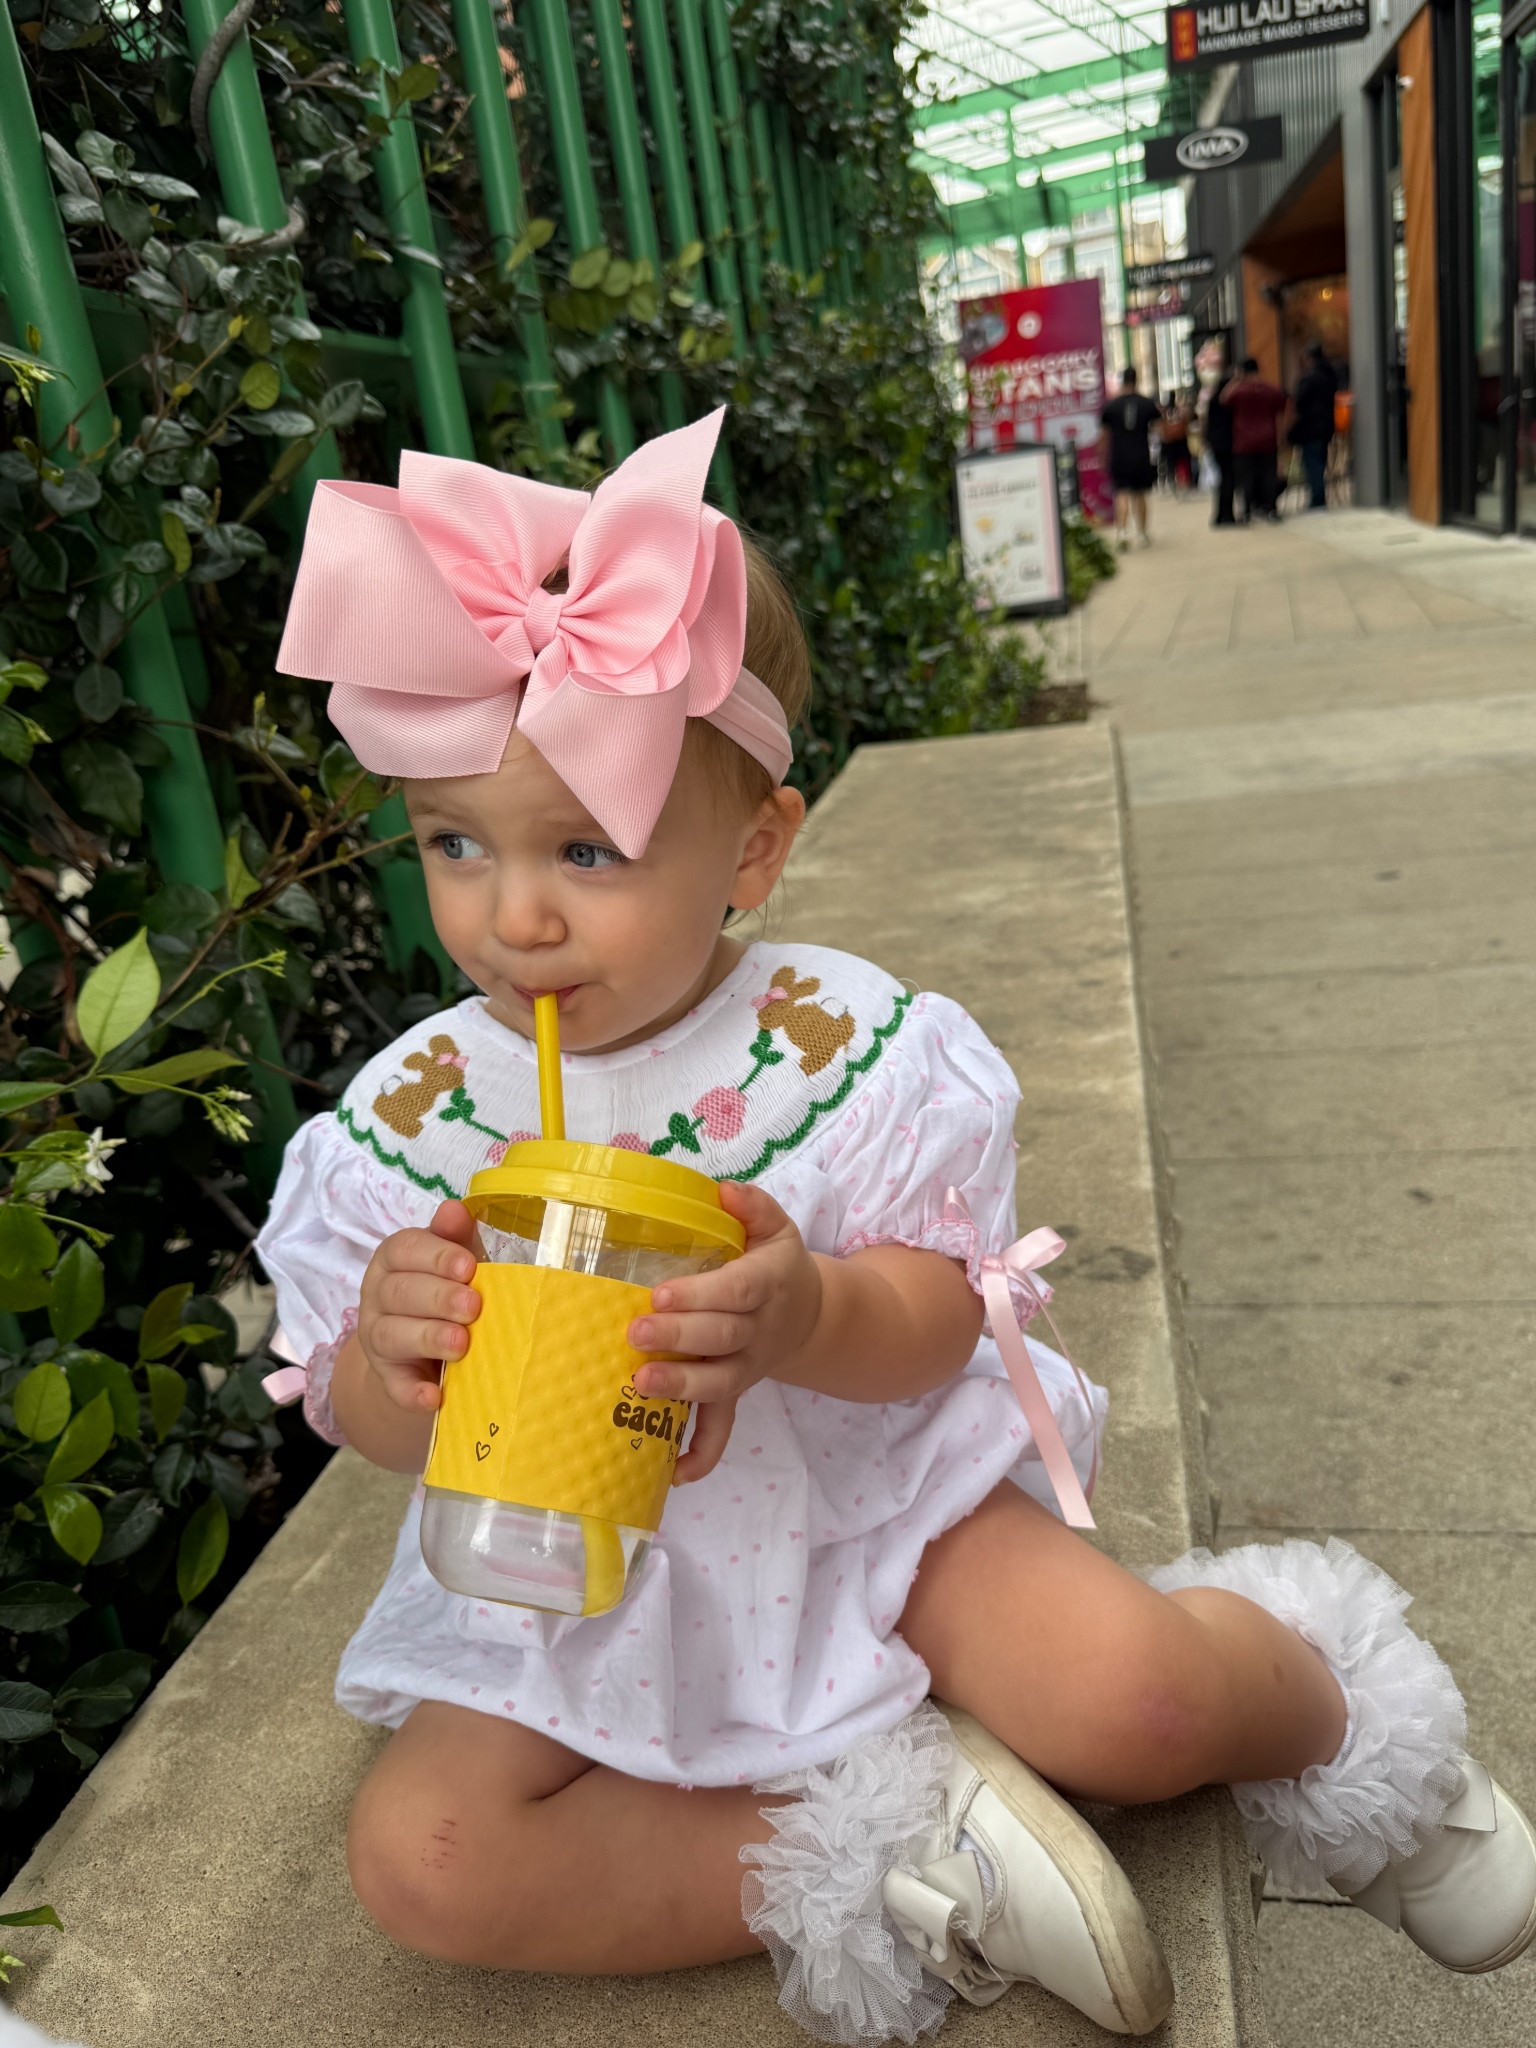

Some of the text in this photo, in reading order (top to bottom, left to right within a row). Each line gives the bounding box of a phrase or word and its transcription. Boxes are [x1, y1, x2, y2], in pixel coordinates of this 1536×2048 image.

[1197, 3, 1238, 36] HUI
[1240, 0, 1290, 28] LAU
[1262, 20, 1304, 44] MANGO
[1305, 9, 1366, 34] DESSERTS
[613, 1402, 674, 1441] each
